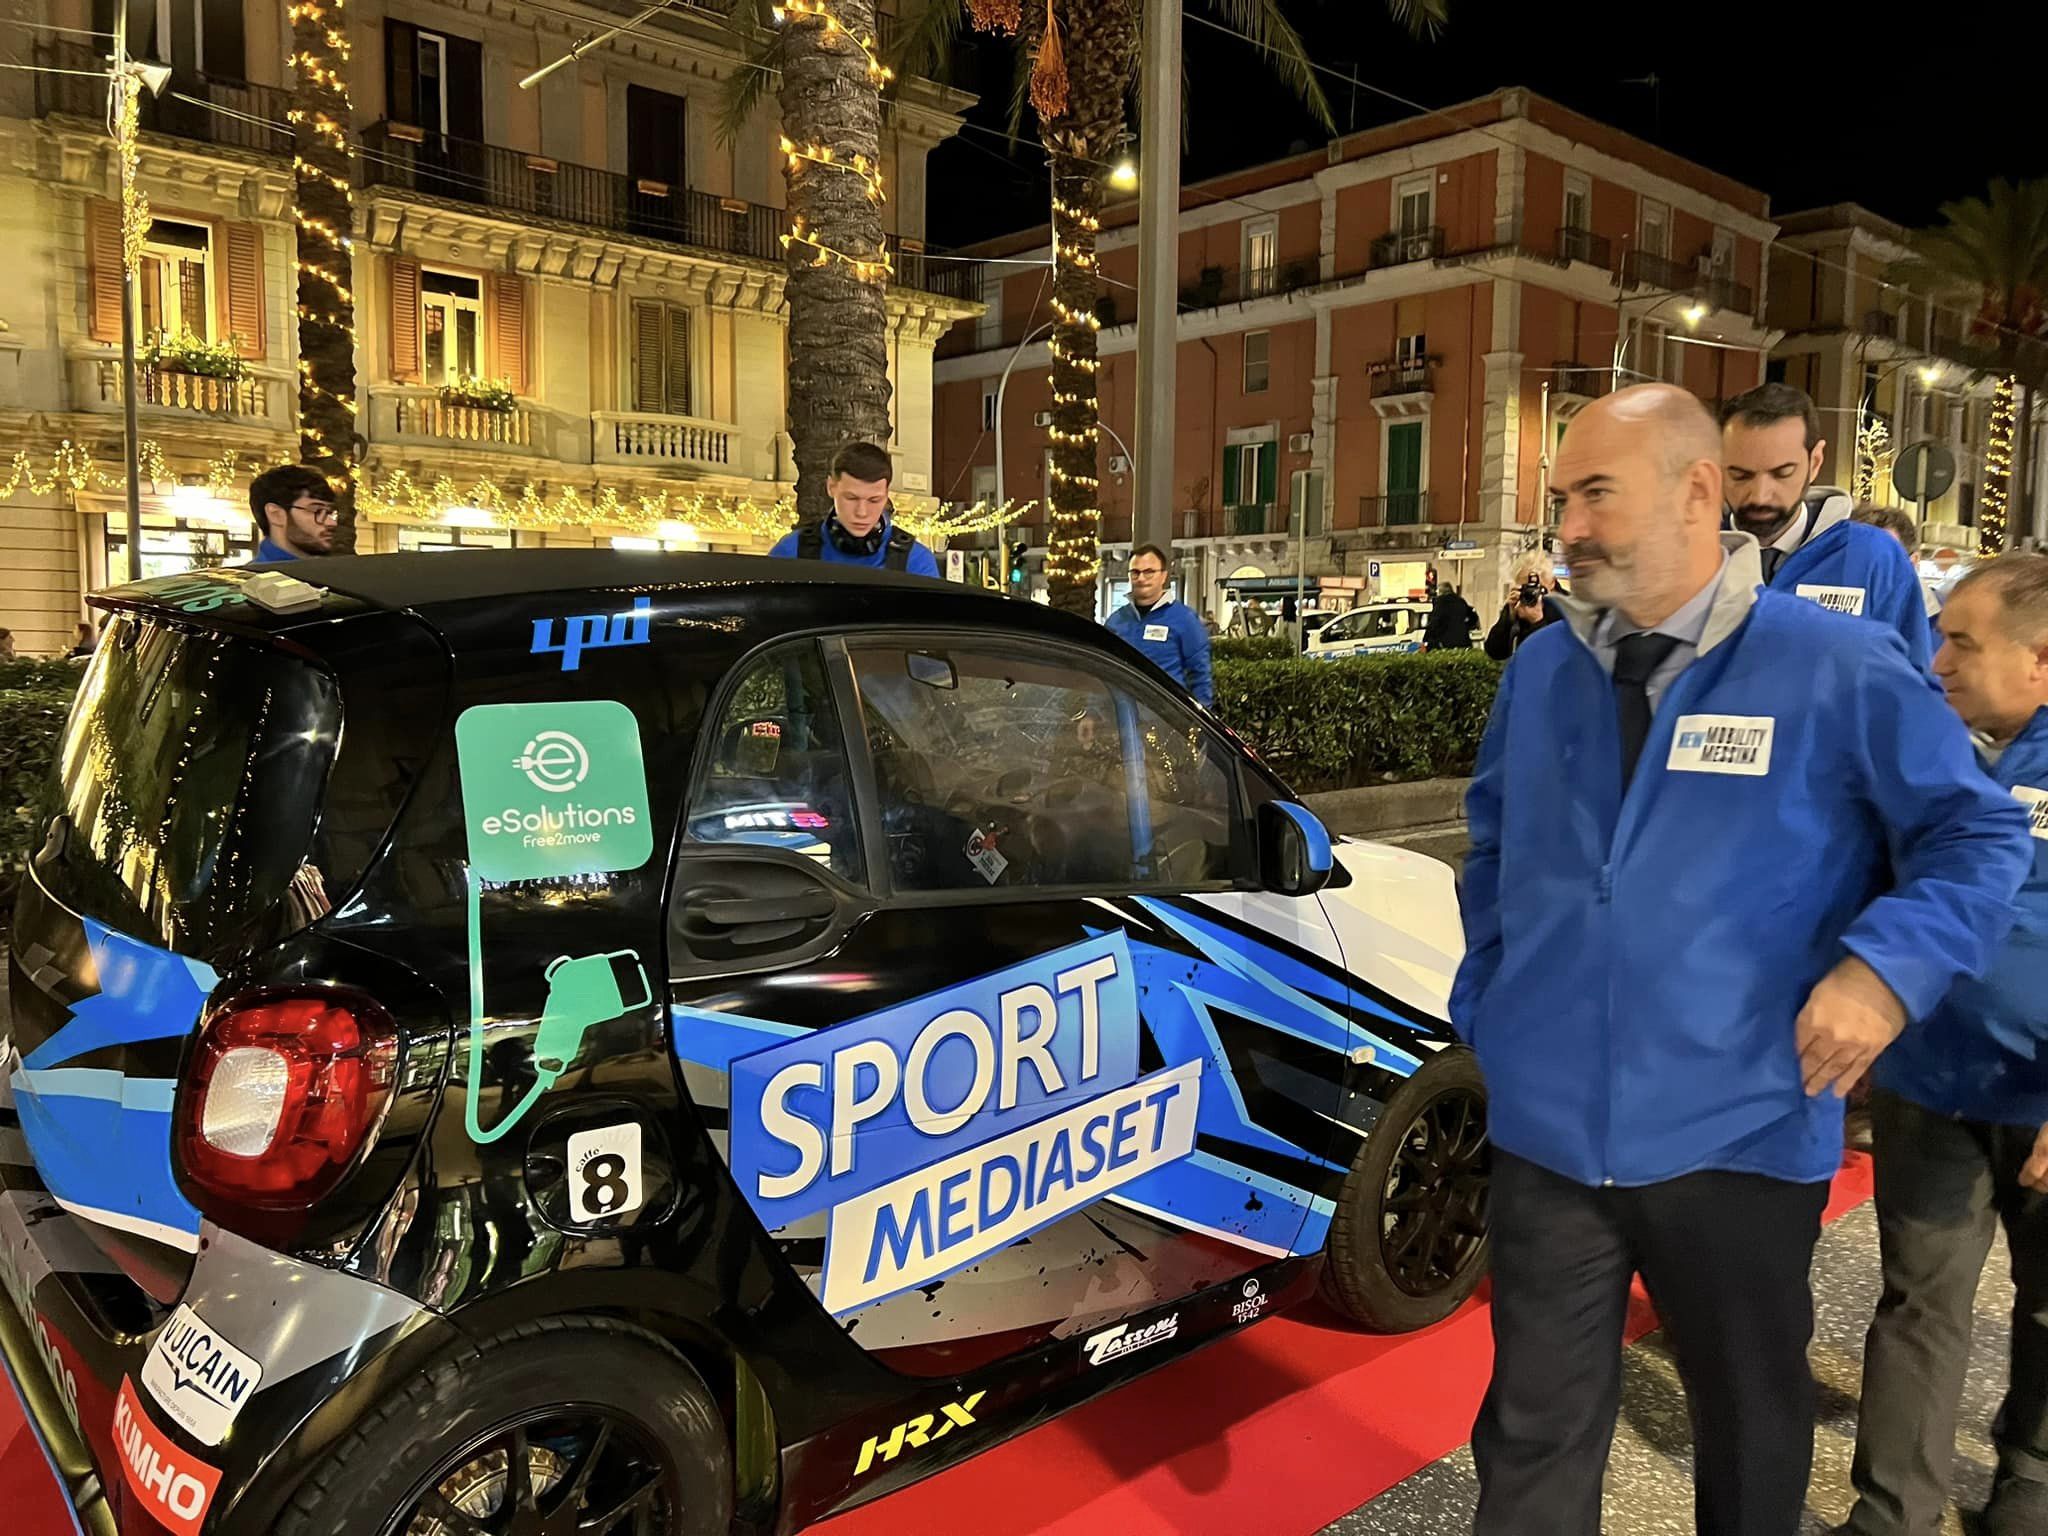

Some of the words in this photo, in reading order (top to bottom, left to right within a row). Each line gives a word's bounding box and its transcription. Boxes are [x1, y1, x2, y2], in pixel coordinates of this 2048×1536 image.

[1819, 593, 1860, 607] MOBILITY
[1705, 726, 1768, 746] MOBILITY
[482, 803, 636, 835] eSolutions
[523, 833, 601, 848] Free2move
[757, 953, 1118, 1200] SPORT
[582, 1153, 629, 1214] 8
[862, 1083, 1183, 1284] MEDIASET
[1232, 1293, 1269, 1317] BISOL
[164, 1317, 250, 1402] VULCAIN
[1084, 1312, 1179, 1366] Tassoni
[115, 1393, 206, 1520] KUMHO
[853, 1390, 987, 1476] HRX
